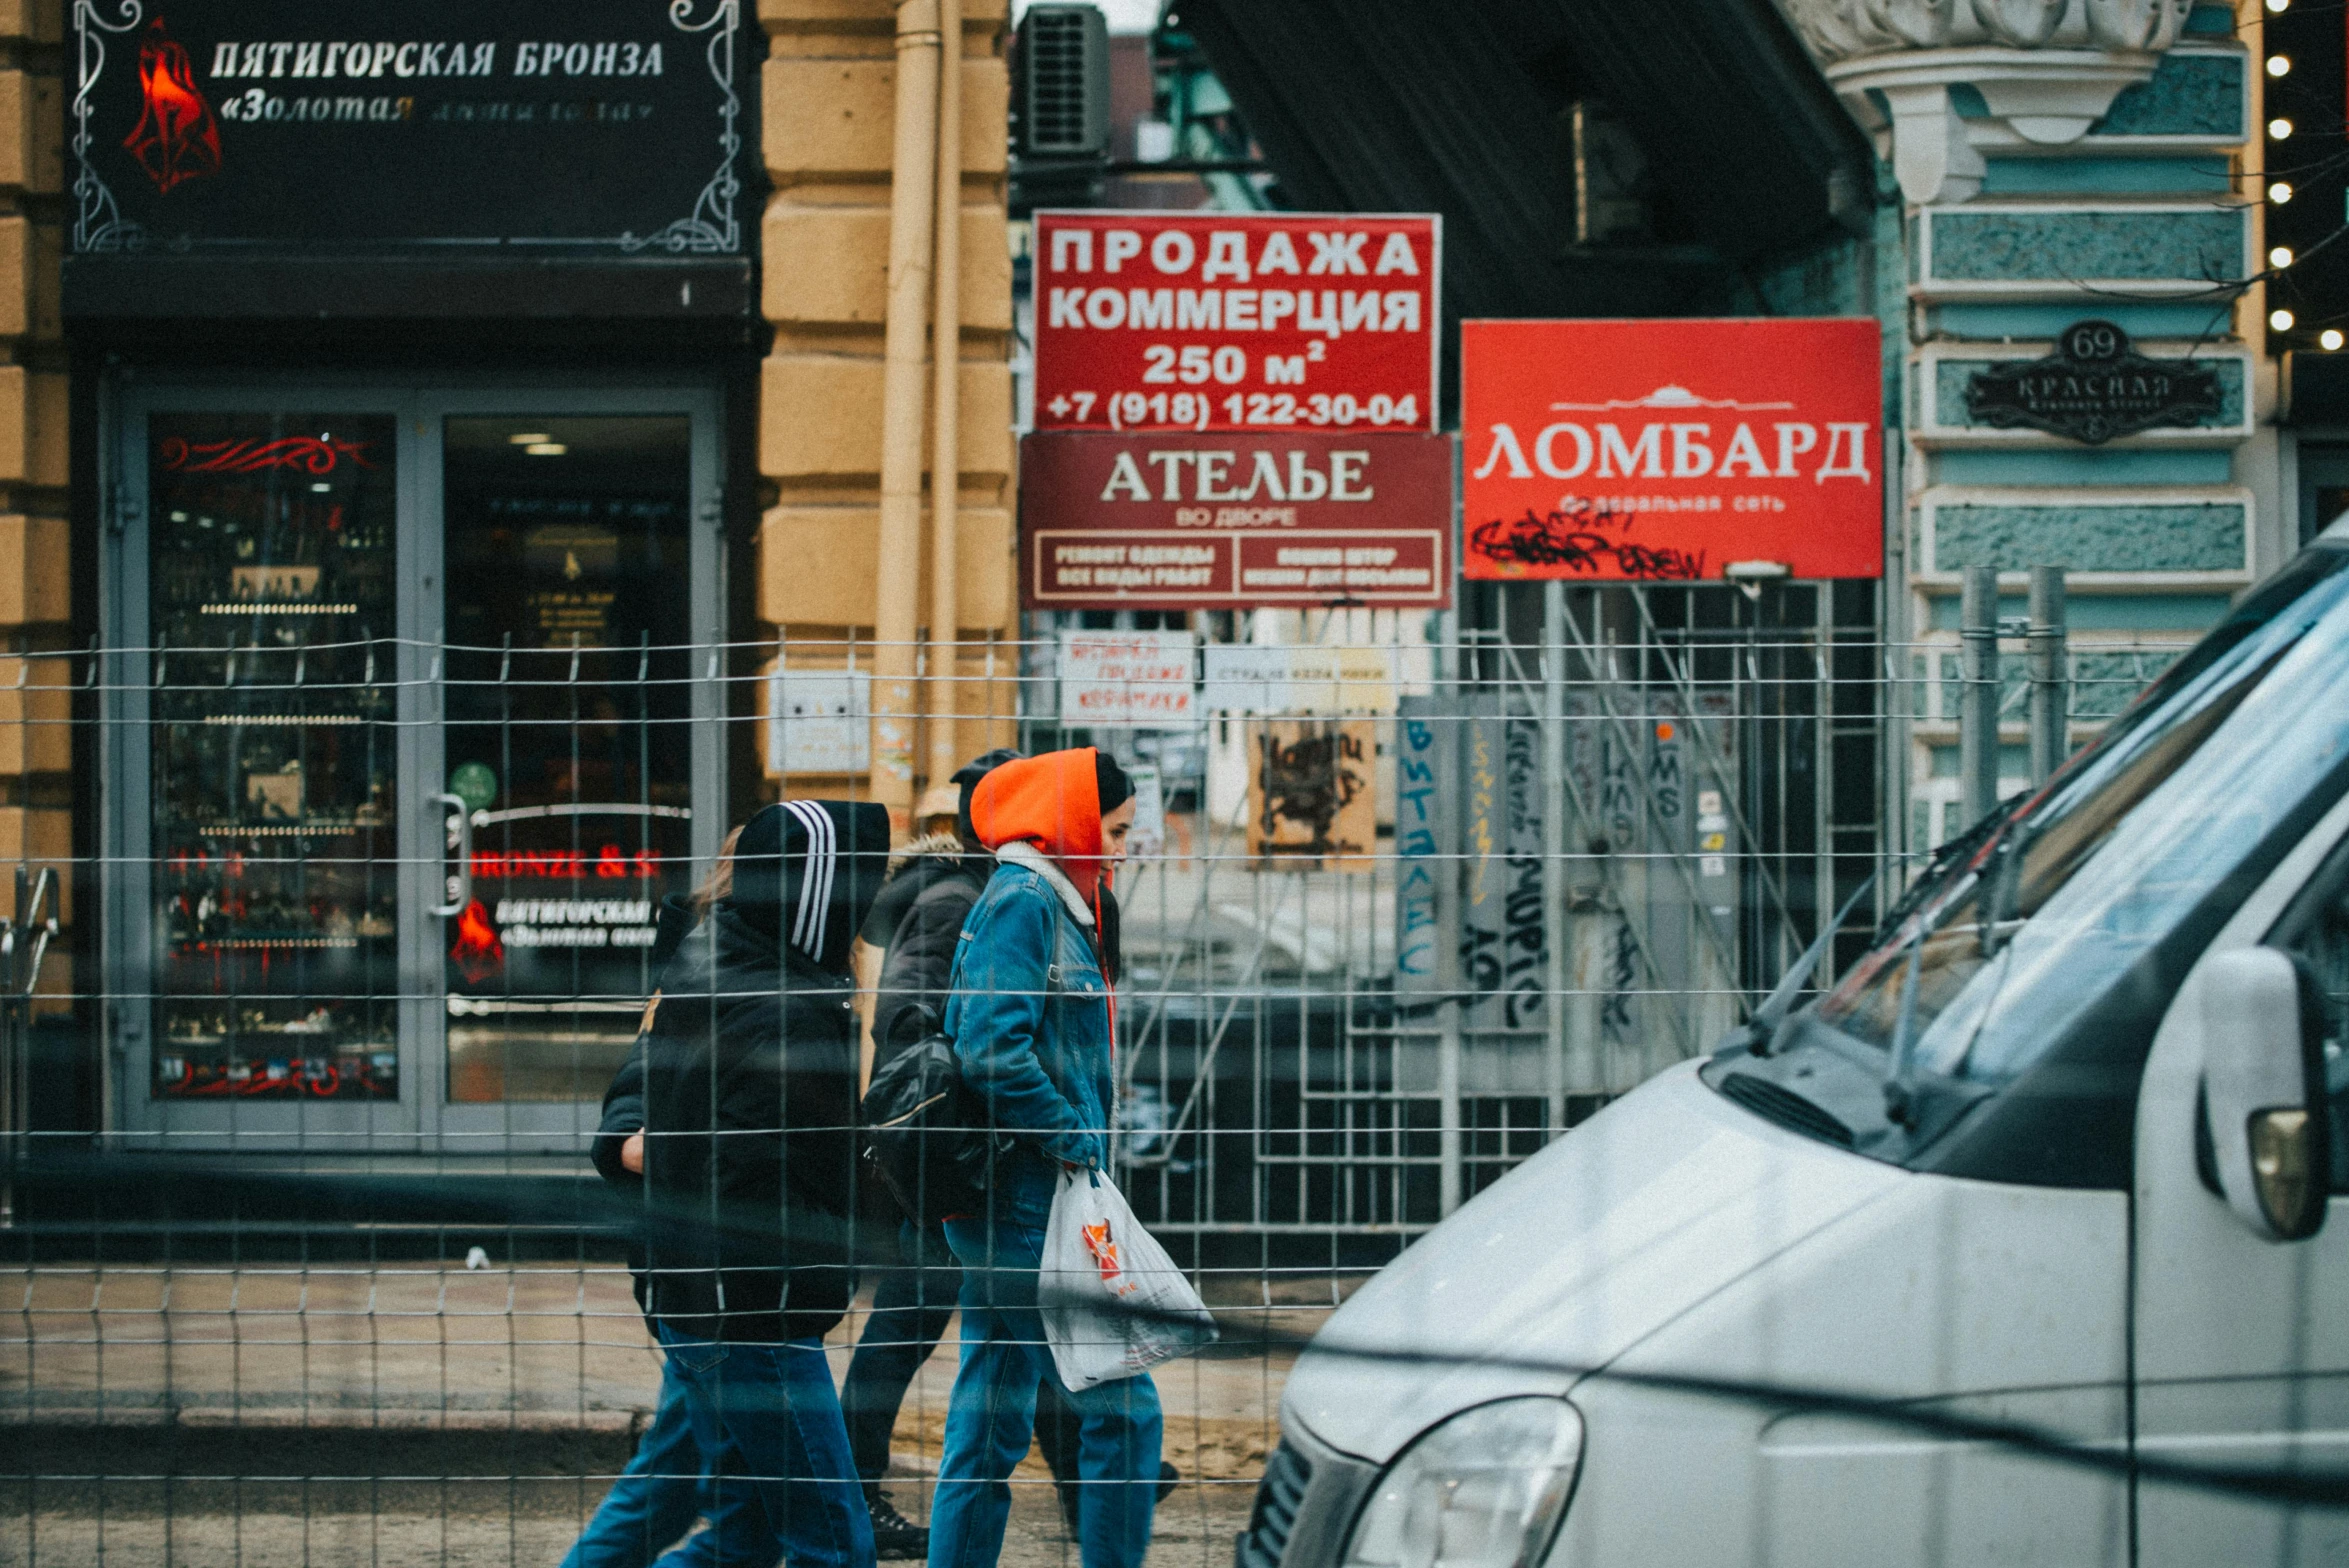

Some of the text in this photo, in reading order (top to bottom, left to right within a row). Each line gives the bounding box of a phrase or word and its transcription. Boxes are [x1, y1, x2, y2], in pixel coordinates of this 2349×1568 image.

[209, 41, 663, 78] ПЯТИГОРСКАЯ БРОНЗА
[220, 88, 414, 122] «Золотая
[1050, 229, 1420, 283] ПРОДАЖА
[1049, 287, 1421, 339] КОММЕРЦИЯ
[2073, 328, 2116, 360] 69
[1142, 344, 1247, 384] 250
[2018, 376, 2170, 397] КРАСНАЯ
[1047, 391, 1419, 431] +7 (918) 122-30-04
[1473, 421, 1871, 485] ЛОМБАРД
[1100, 450, 1374, 502] АТЕЛЬЕ
[1175, 507, 1297, 528] ВО ДВОРЕ
[1732, 496, 1786, 513] сеть
